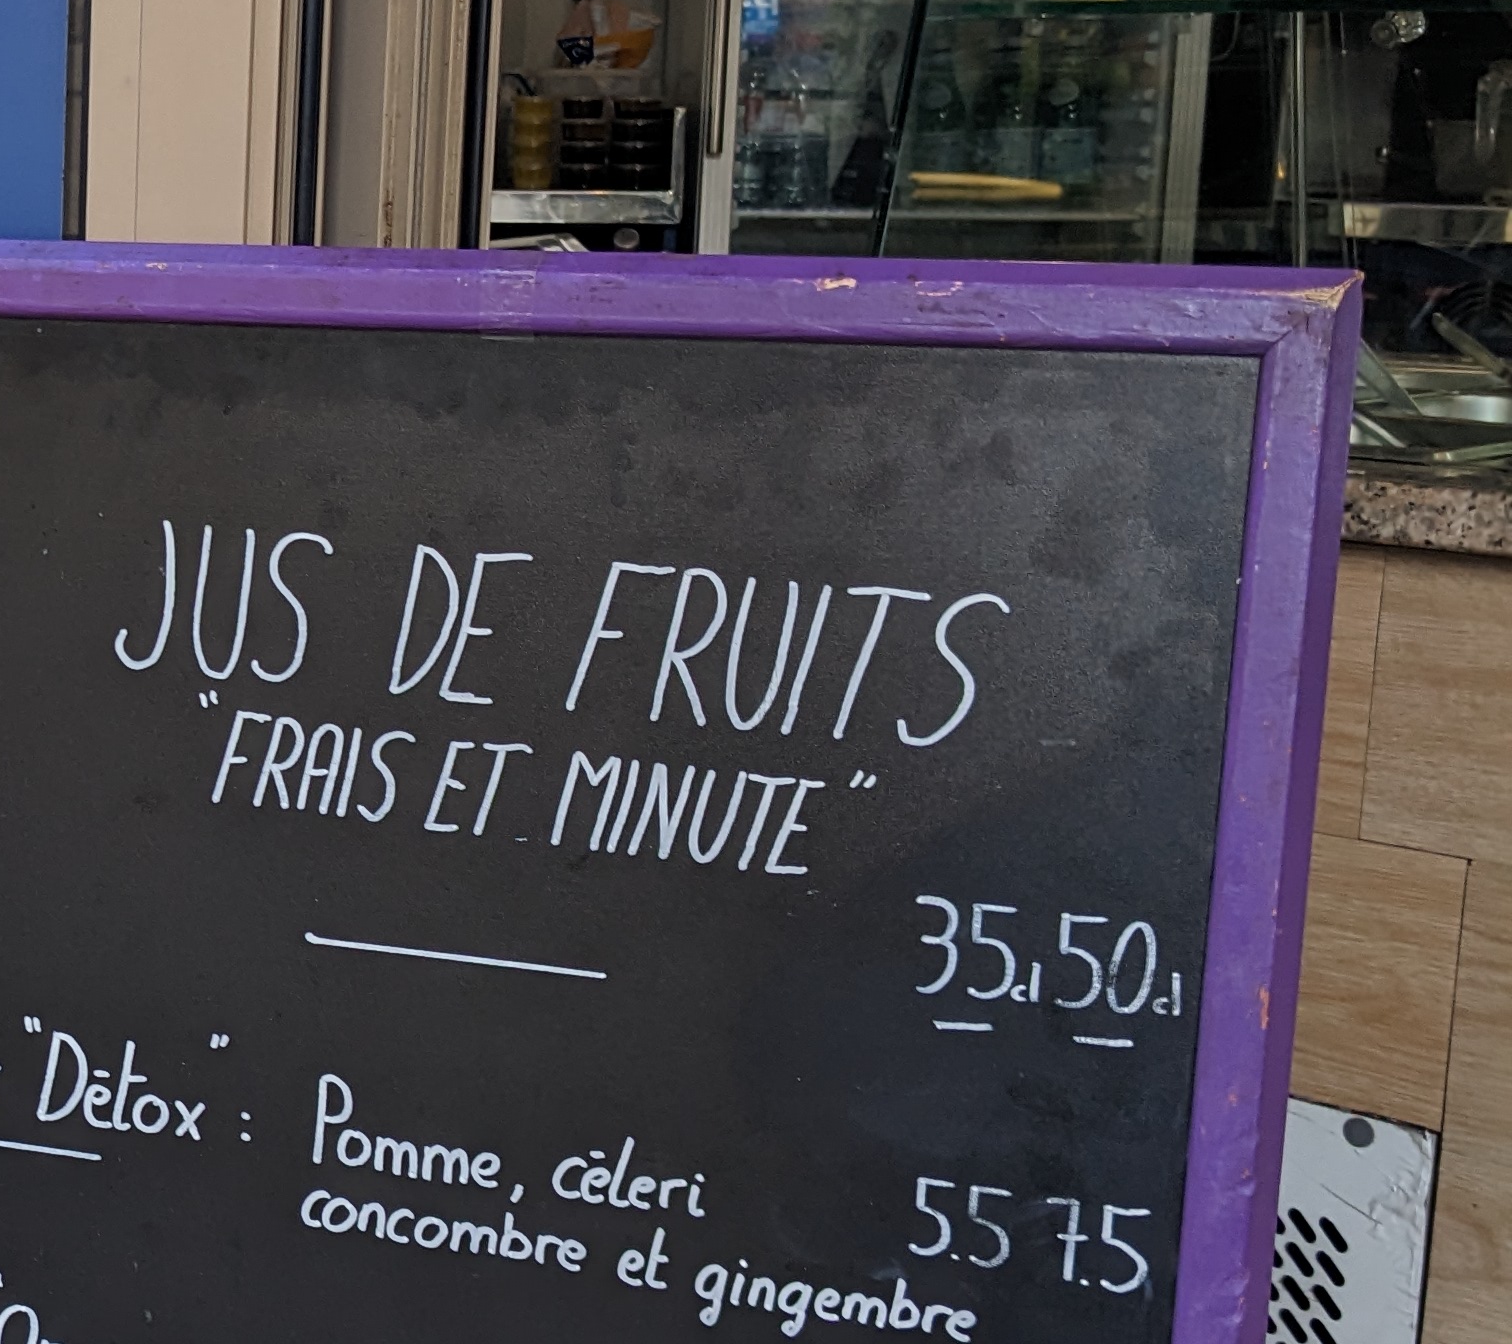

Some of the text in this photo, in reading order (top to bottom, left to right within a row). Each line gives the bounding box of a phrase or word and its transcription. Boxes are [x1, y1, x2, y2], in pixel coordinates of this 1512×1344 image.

[114, 519, 1011, 747] JUS DE FRUITS
[198, 689, 877, 875] "FRAIS ET MINUTE"
[312, 1072, 526, 1203] Pomme,
[551, 1136, 706, 1218] céleri
[300, 1189, 979, 1344] concombre et gingembre
